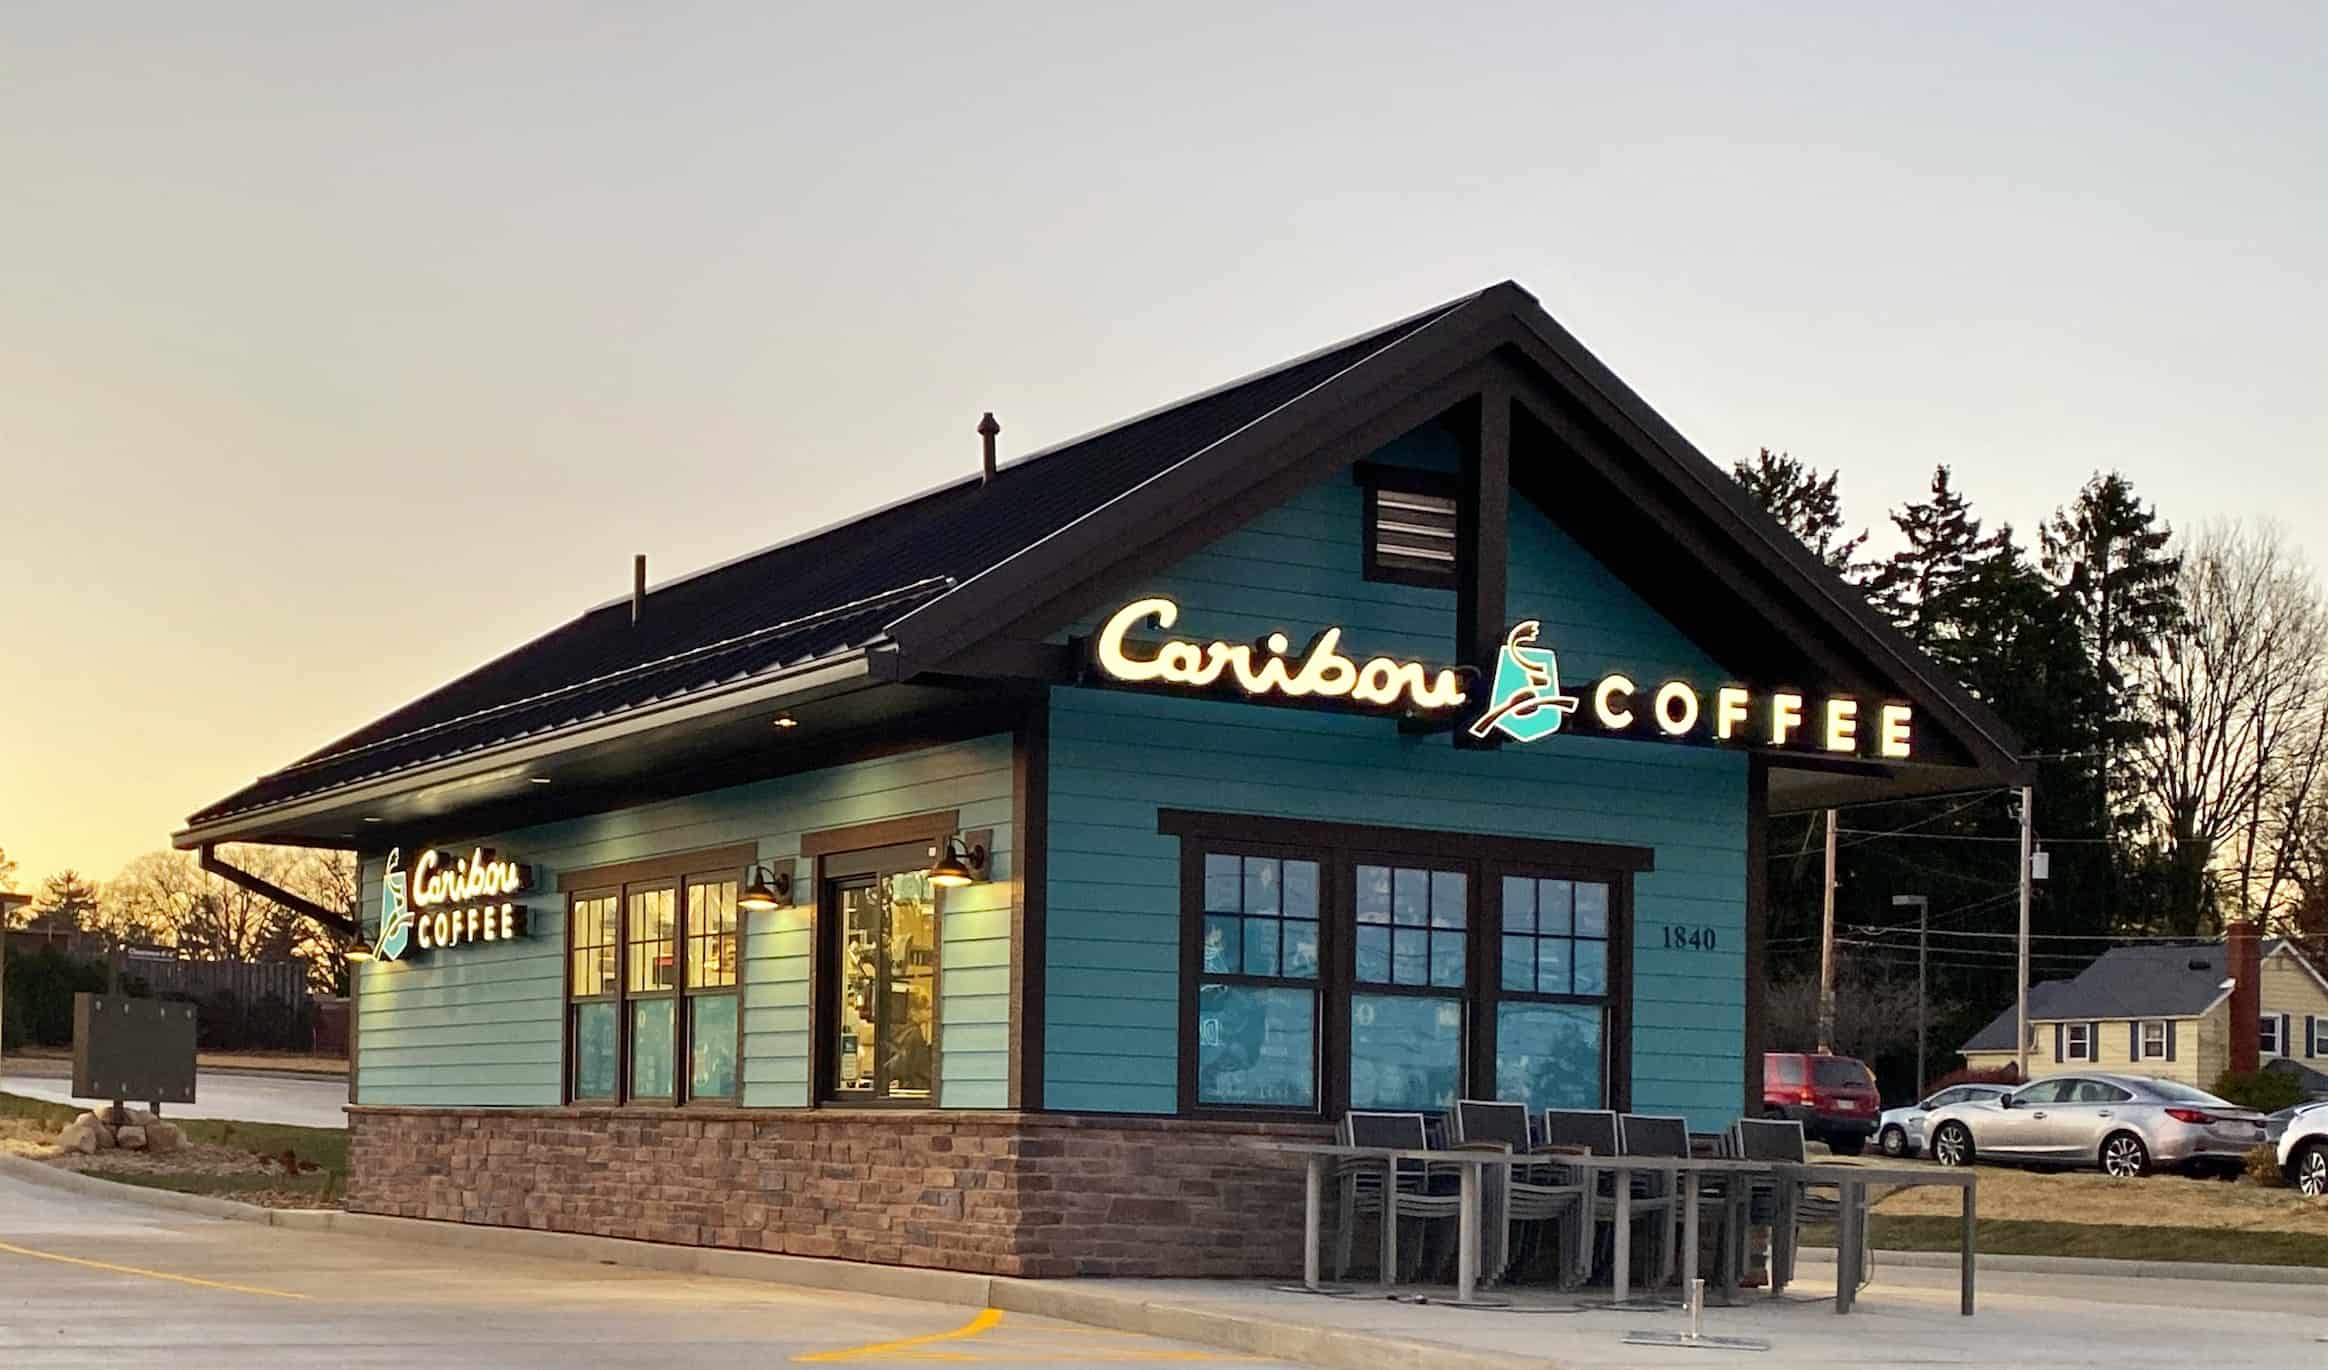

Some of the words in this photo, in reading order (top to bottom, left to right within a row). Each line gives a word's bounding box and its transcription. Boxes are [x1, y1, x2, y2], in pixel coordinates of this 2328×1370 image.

[1097, 597, 1467, 709] Caribou
[1594, 673, 1913, 758] COFFEE
[412, 847, 520, 906] Caribou
[417, 903, 513, 949] COFFEE
[1663, 926, 1716, 951] 1840
